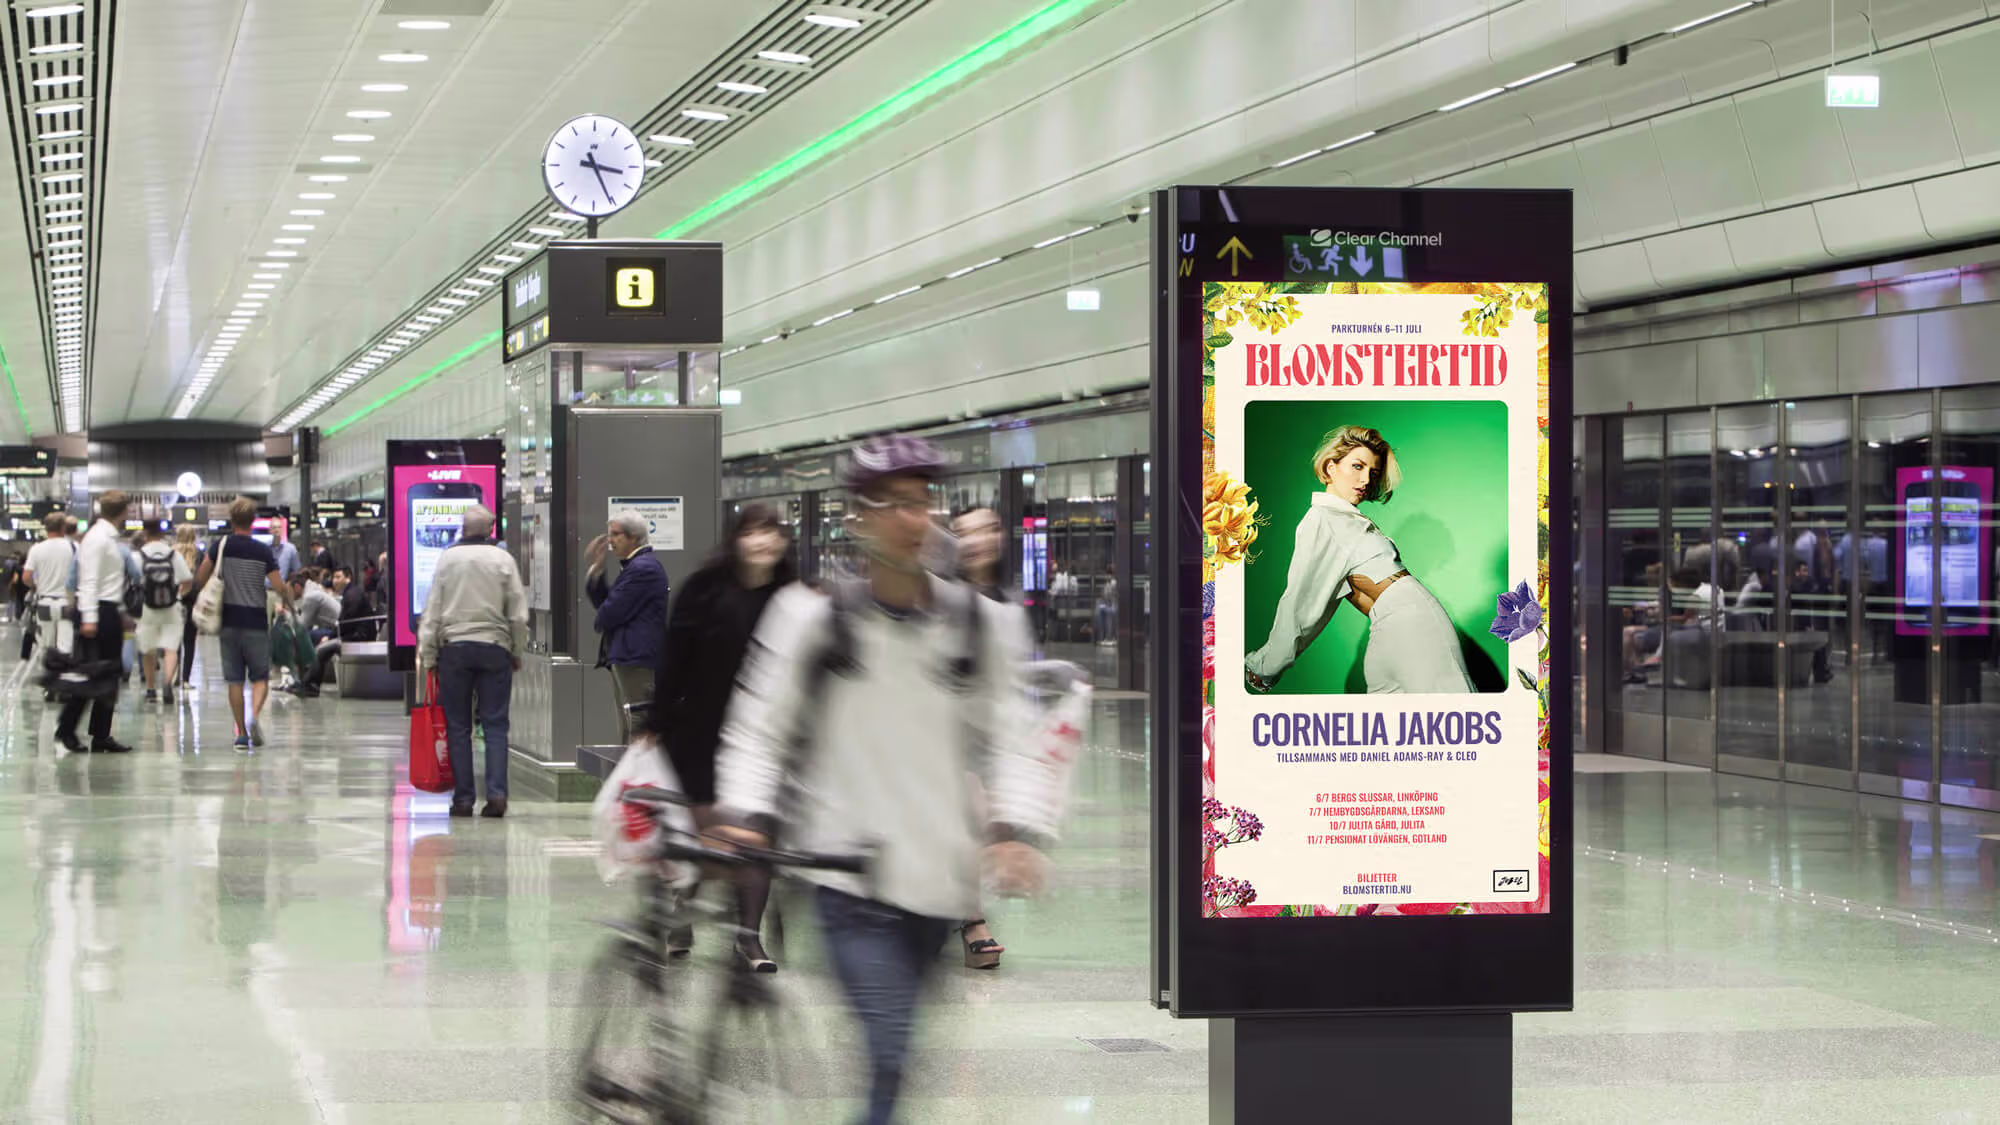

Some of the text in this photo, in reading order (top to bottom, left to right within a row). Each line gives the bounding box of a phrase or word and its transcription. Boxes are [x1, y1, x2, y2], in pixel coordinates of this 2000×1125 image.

[1334, 231, 1442, 246] Clear Channel
[1331, 321, 1383, 334] PARKTURNÉN
[1405, 324, 1422, 334] JULI
[1245, 343, 1508, 387] BLOMSTERTID
[1252, 710, 1503, 747] CORNELIA JAKOBS
[1277, 751, 1478, 763] TILLSAMMANS MED DANIEL ADAMS-RAY & CLEO
[1315, 790, 1439, 803] 6/7 BERGS SLUSSAR, LINKÖPING
[1308, 807, 1322, 817] 7/7
[1411, 806, 1446, 816] LEKSAND
[1329, 818, 1426, 831] 10/7 JULITA GÅRD, JULITA
[1307, 834, 1324, 845] 11/7
[1325, 834, 1368, 845] PENSIONAT
[1412, 834, 1448, 844] GOTLAND
[1356, 873, 1398, 883] BILJETTER
[1342, 884, 1412, 895] BLOMSTERTID.NU
